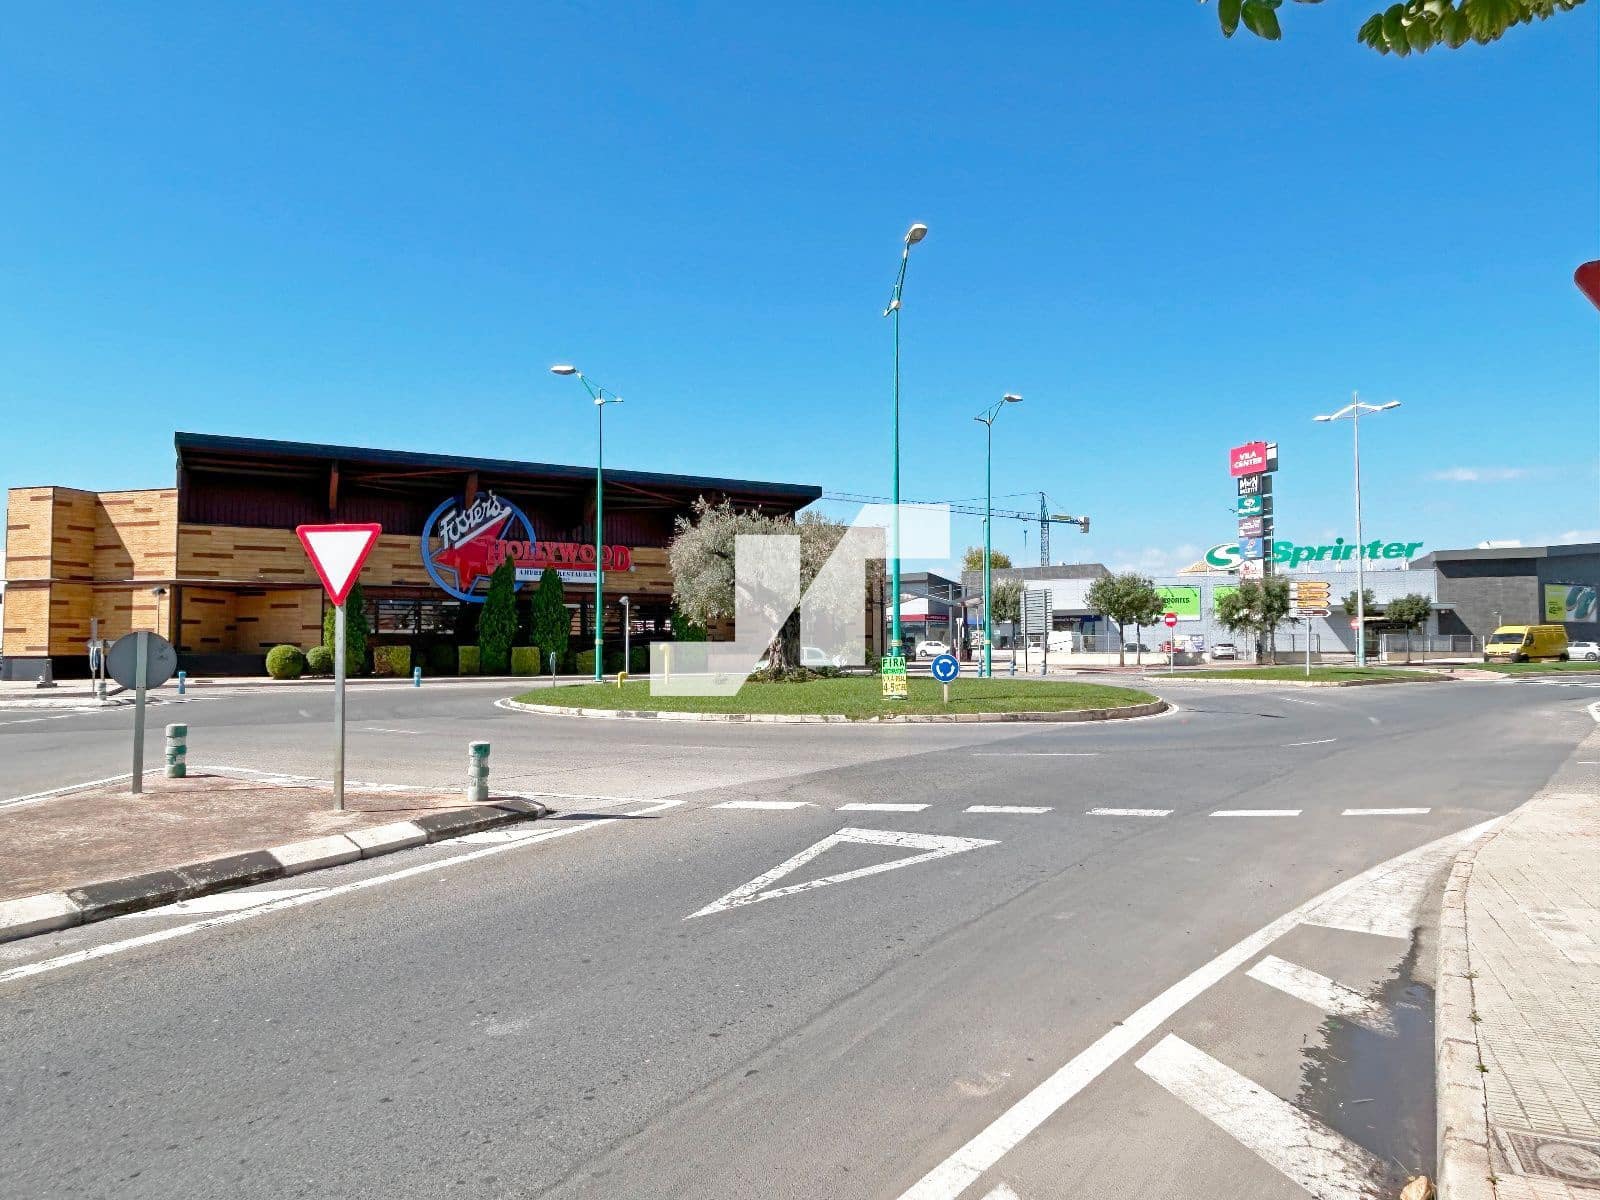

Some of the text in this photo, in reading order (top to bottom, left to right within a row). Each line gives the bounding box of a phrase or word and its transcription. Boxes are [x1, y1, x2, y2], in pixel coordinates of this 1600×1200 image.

[440, 490, 504, 549] Foster's
[487, 539, 632, 573] HOLLYWOOD
[1272, 537, 1423, 569] Sprinter
[882, 658, 905, 668] FIRA
